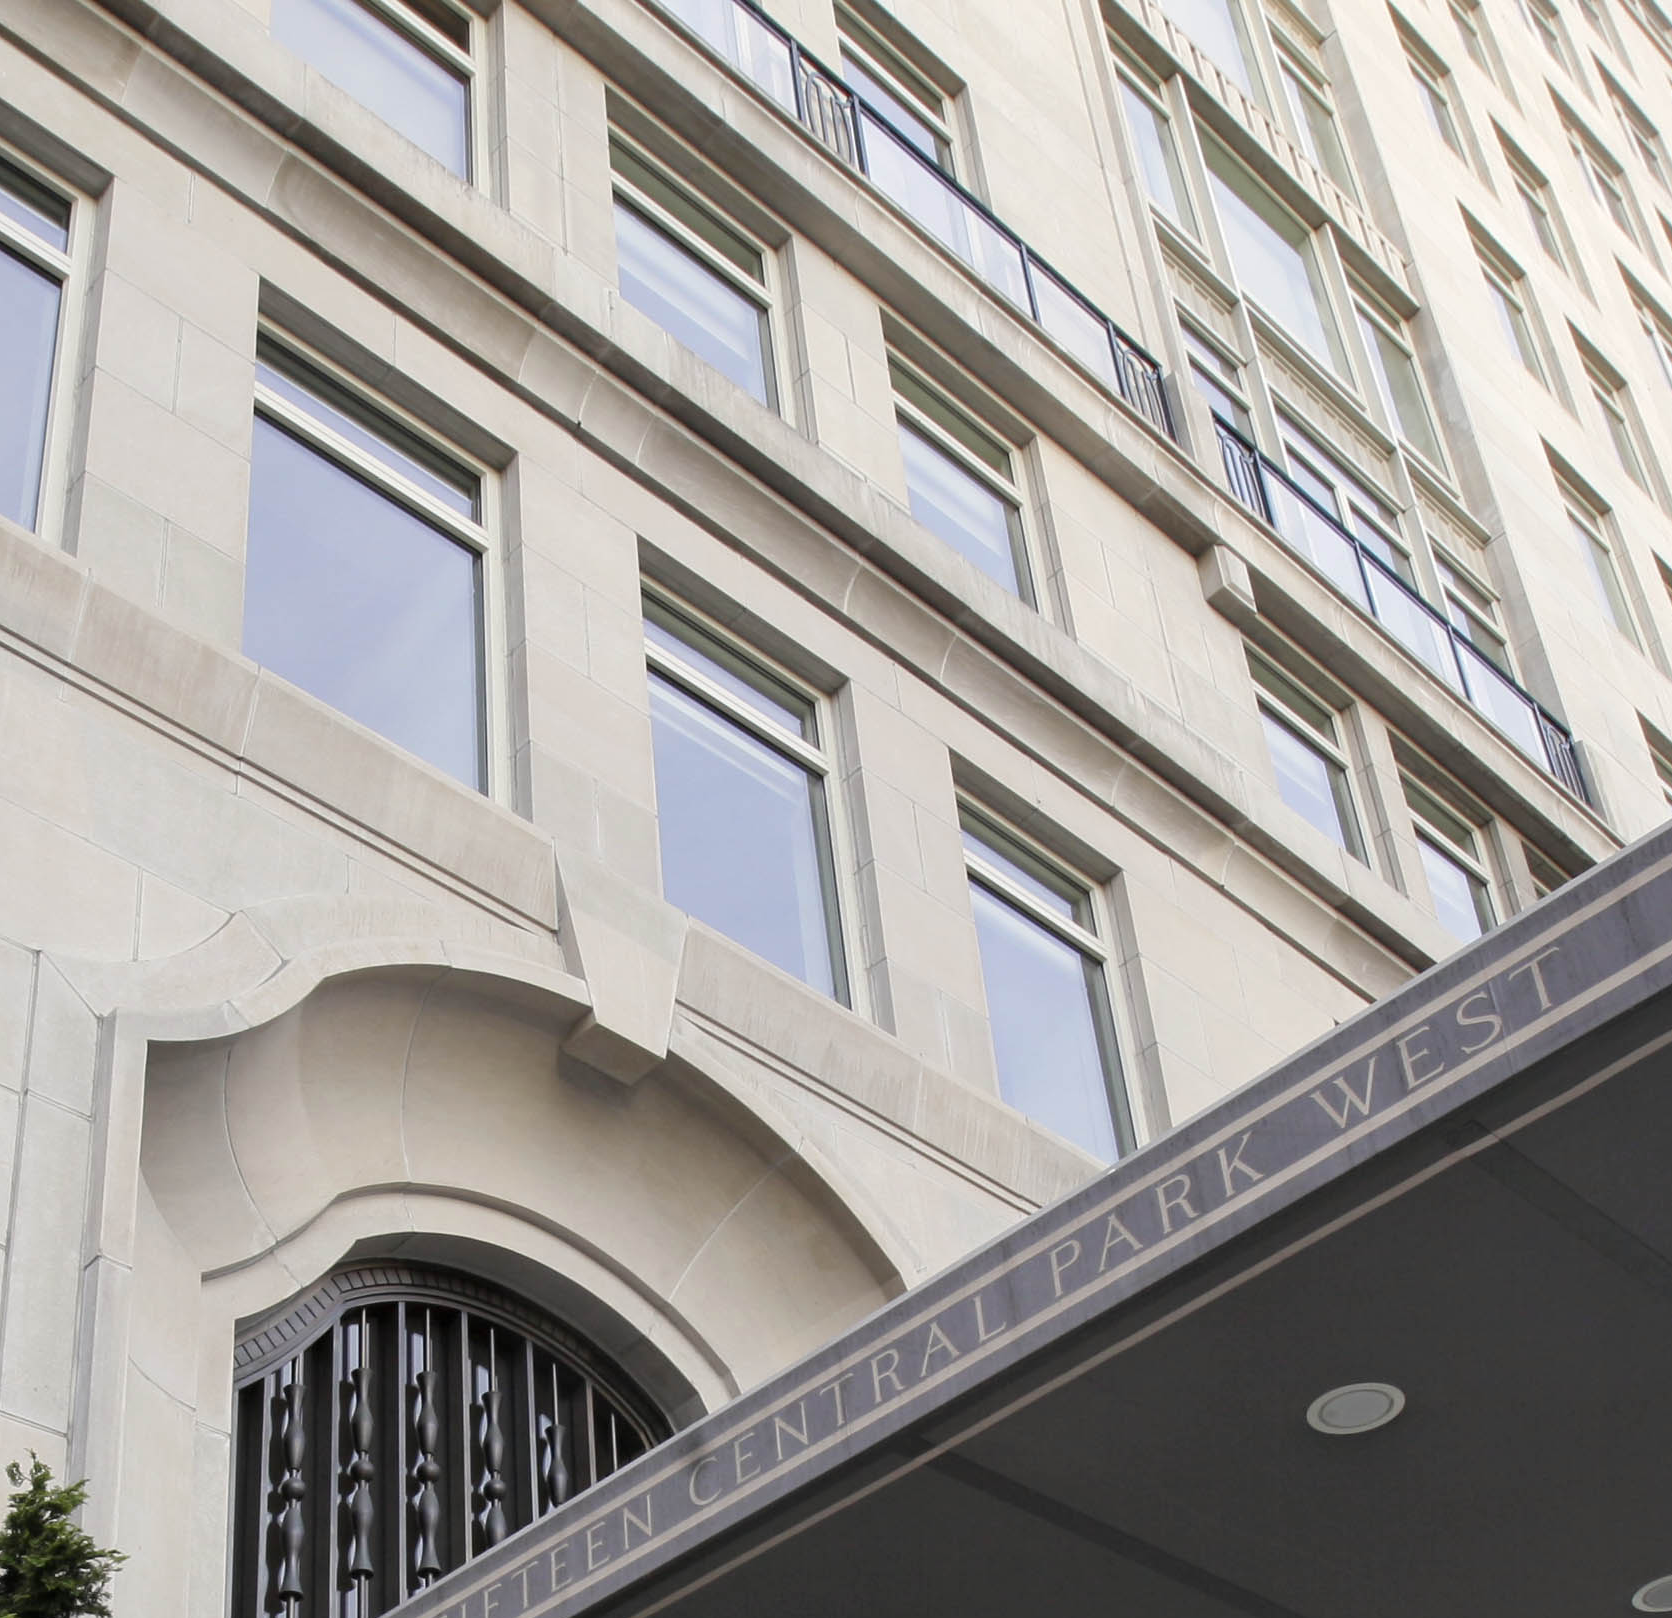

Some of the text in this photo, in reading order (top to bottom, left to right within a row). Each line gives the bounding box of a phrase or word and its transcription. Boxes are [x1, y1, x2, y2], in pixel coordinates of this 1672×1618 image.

[688, 1294, 1009, 1507] CENTRAL
[1046, 1132, 1265, 1298] PARK
[1308, 946, 1562, 1130] WEST
